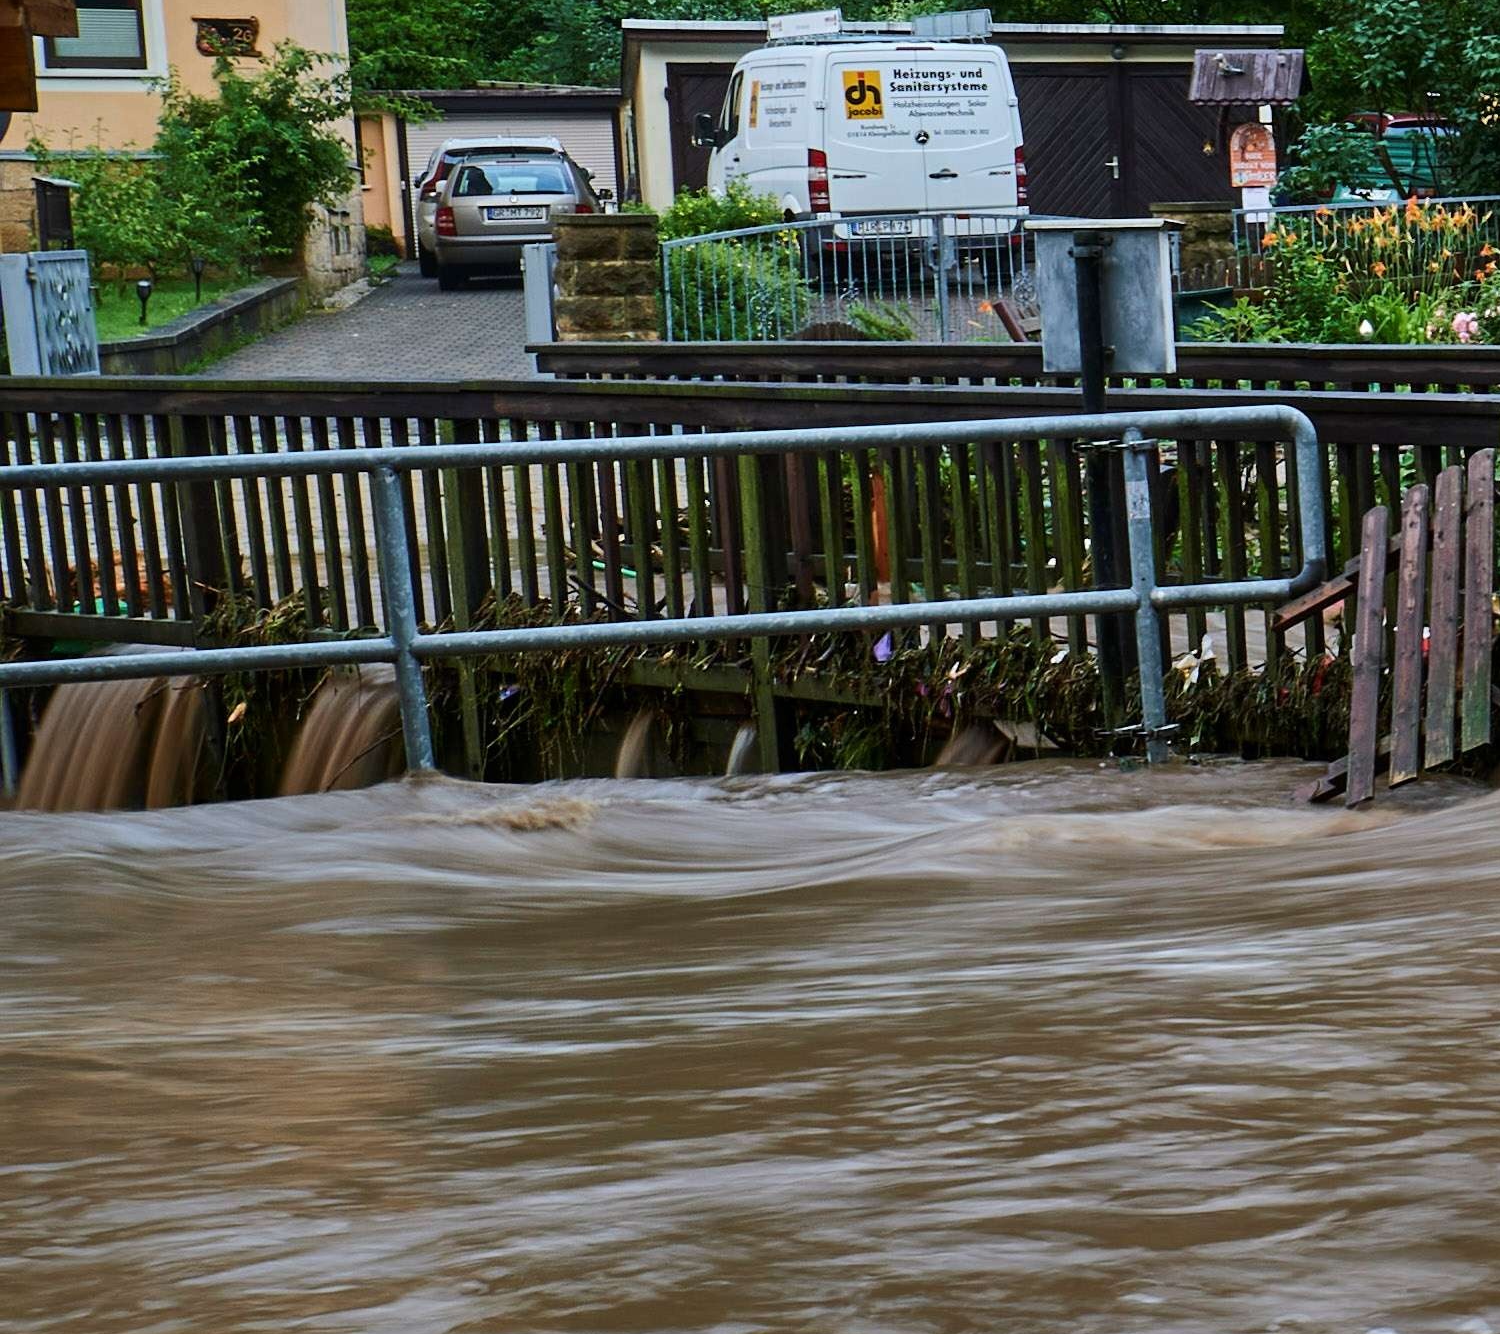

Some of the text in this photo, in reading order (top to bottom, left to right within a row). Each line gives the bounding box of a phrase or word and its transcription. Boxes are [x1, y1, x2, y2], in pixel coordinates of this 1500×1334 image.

[233, 27, 253, 42] 26
[893, 67, 983, 81] Heizungs- und
[889, 81, 988, 94] Sanitärsysteme
[847, 106, 883, 120] jacobi
